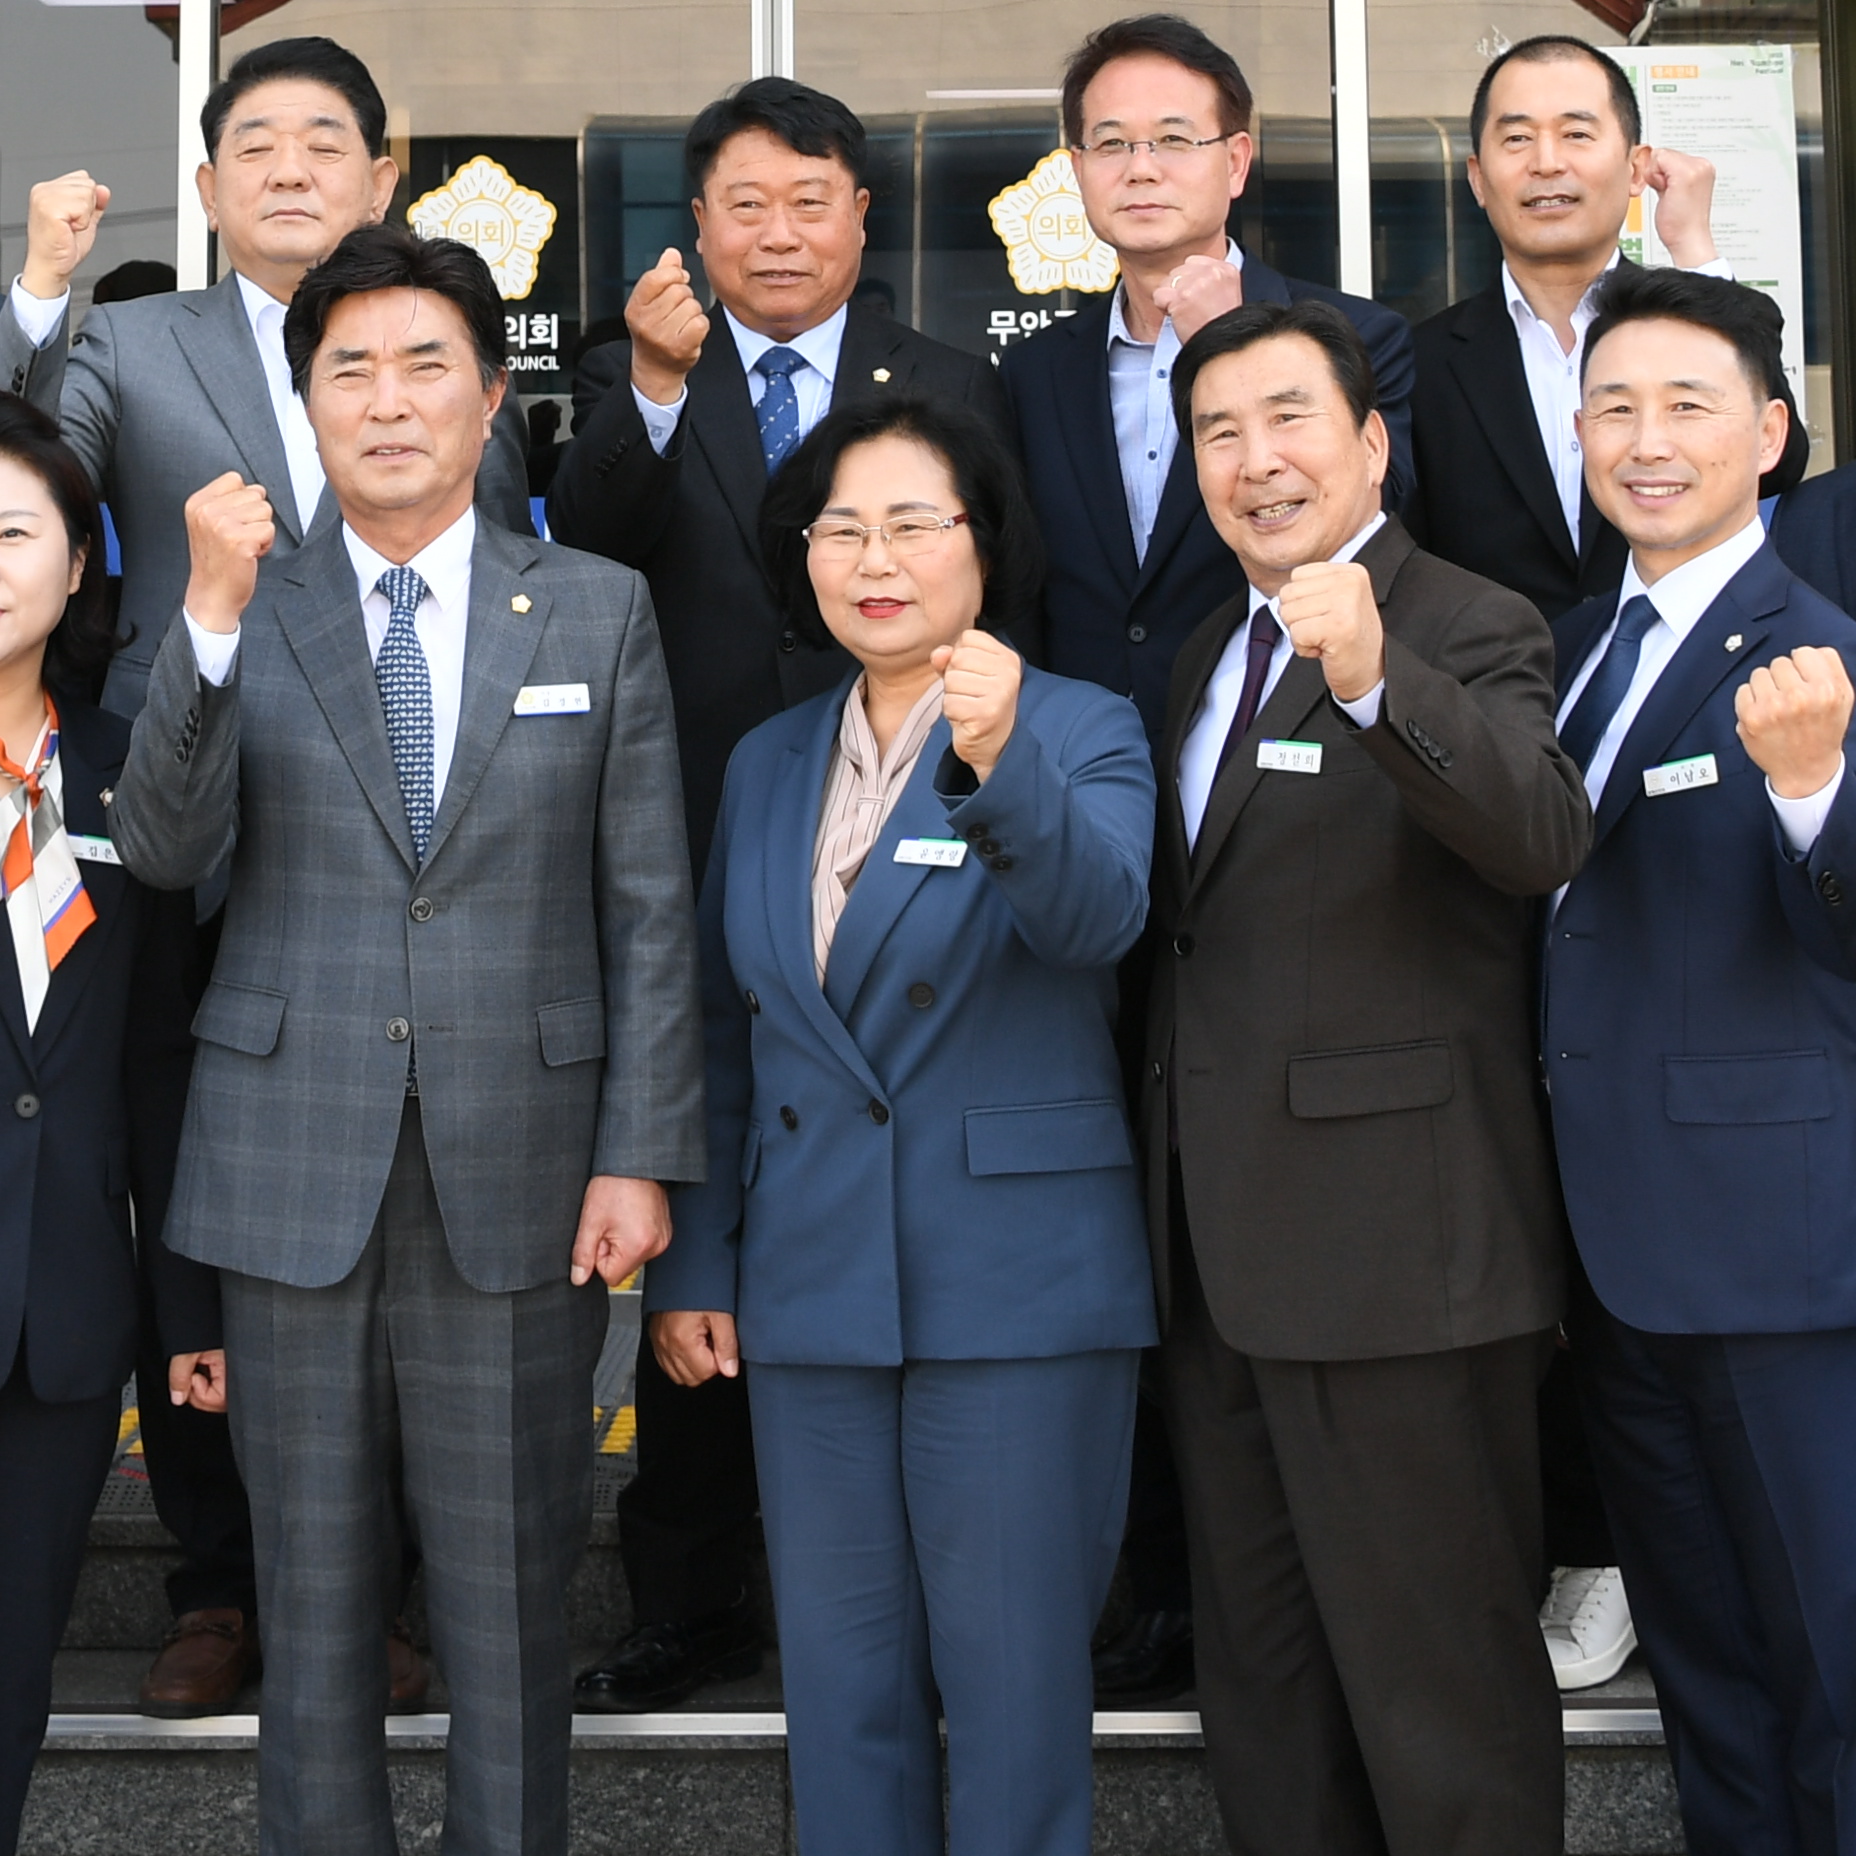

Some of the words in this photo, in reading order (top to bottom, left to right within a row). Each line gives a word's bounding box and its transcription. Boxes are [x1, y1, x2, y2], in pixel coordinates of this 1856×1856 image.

[458, 219, 505, 247] 의회
[1039, 213, 1087, 241] 의회
[505, 313, 559, 350] 의회
[986, 309, 1078, 346] 무안
[507, 355, 560, 371] OUNCIL
